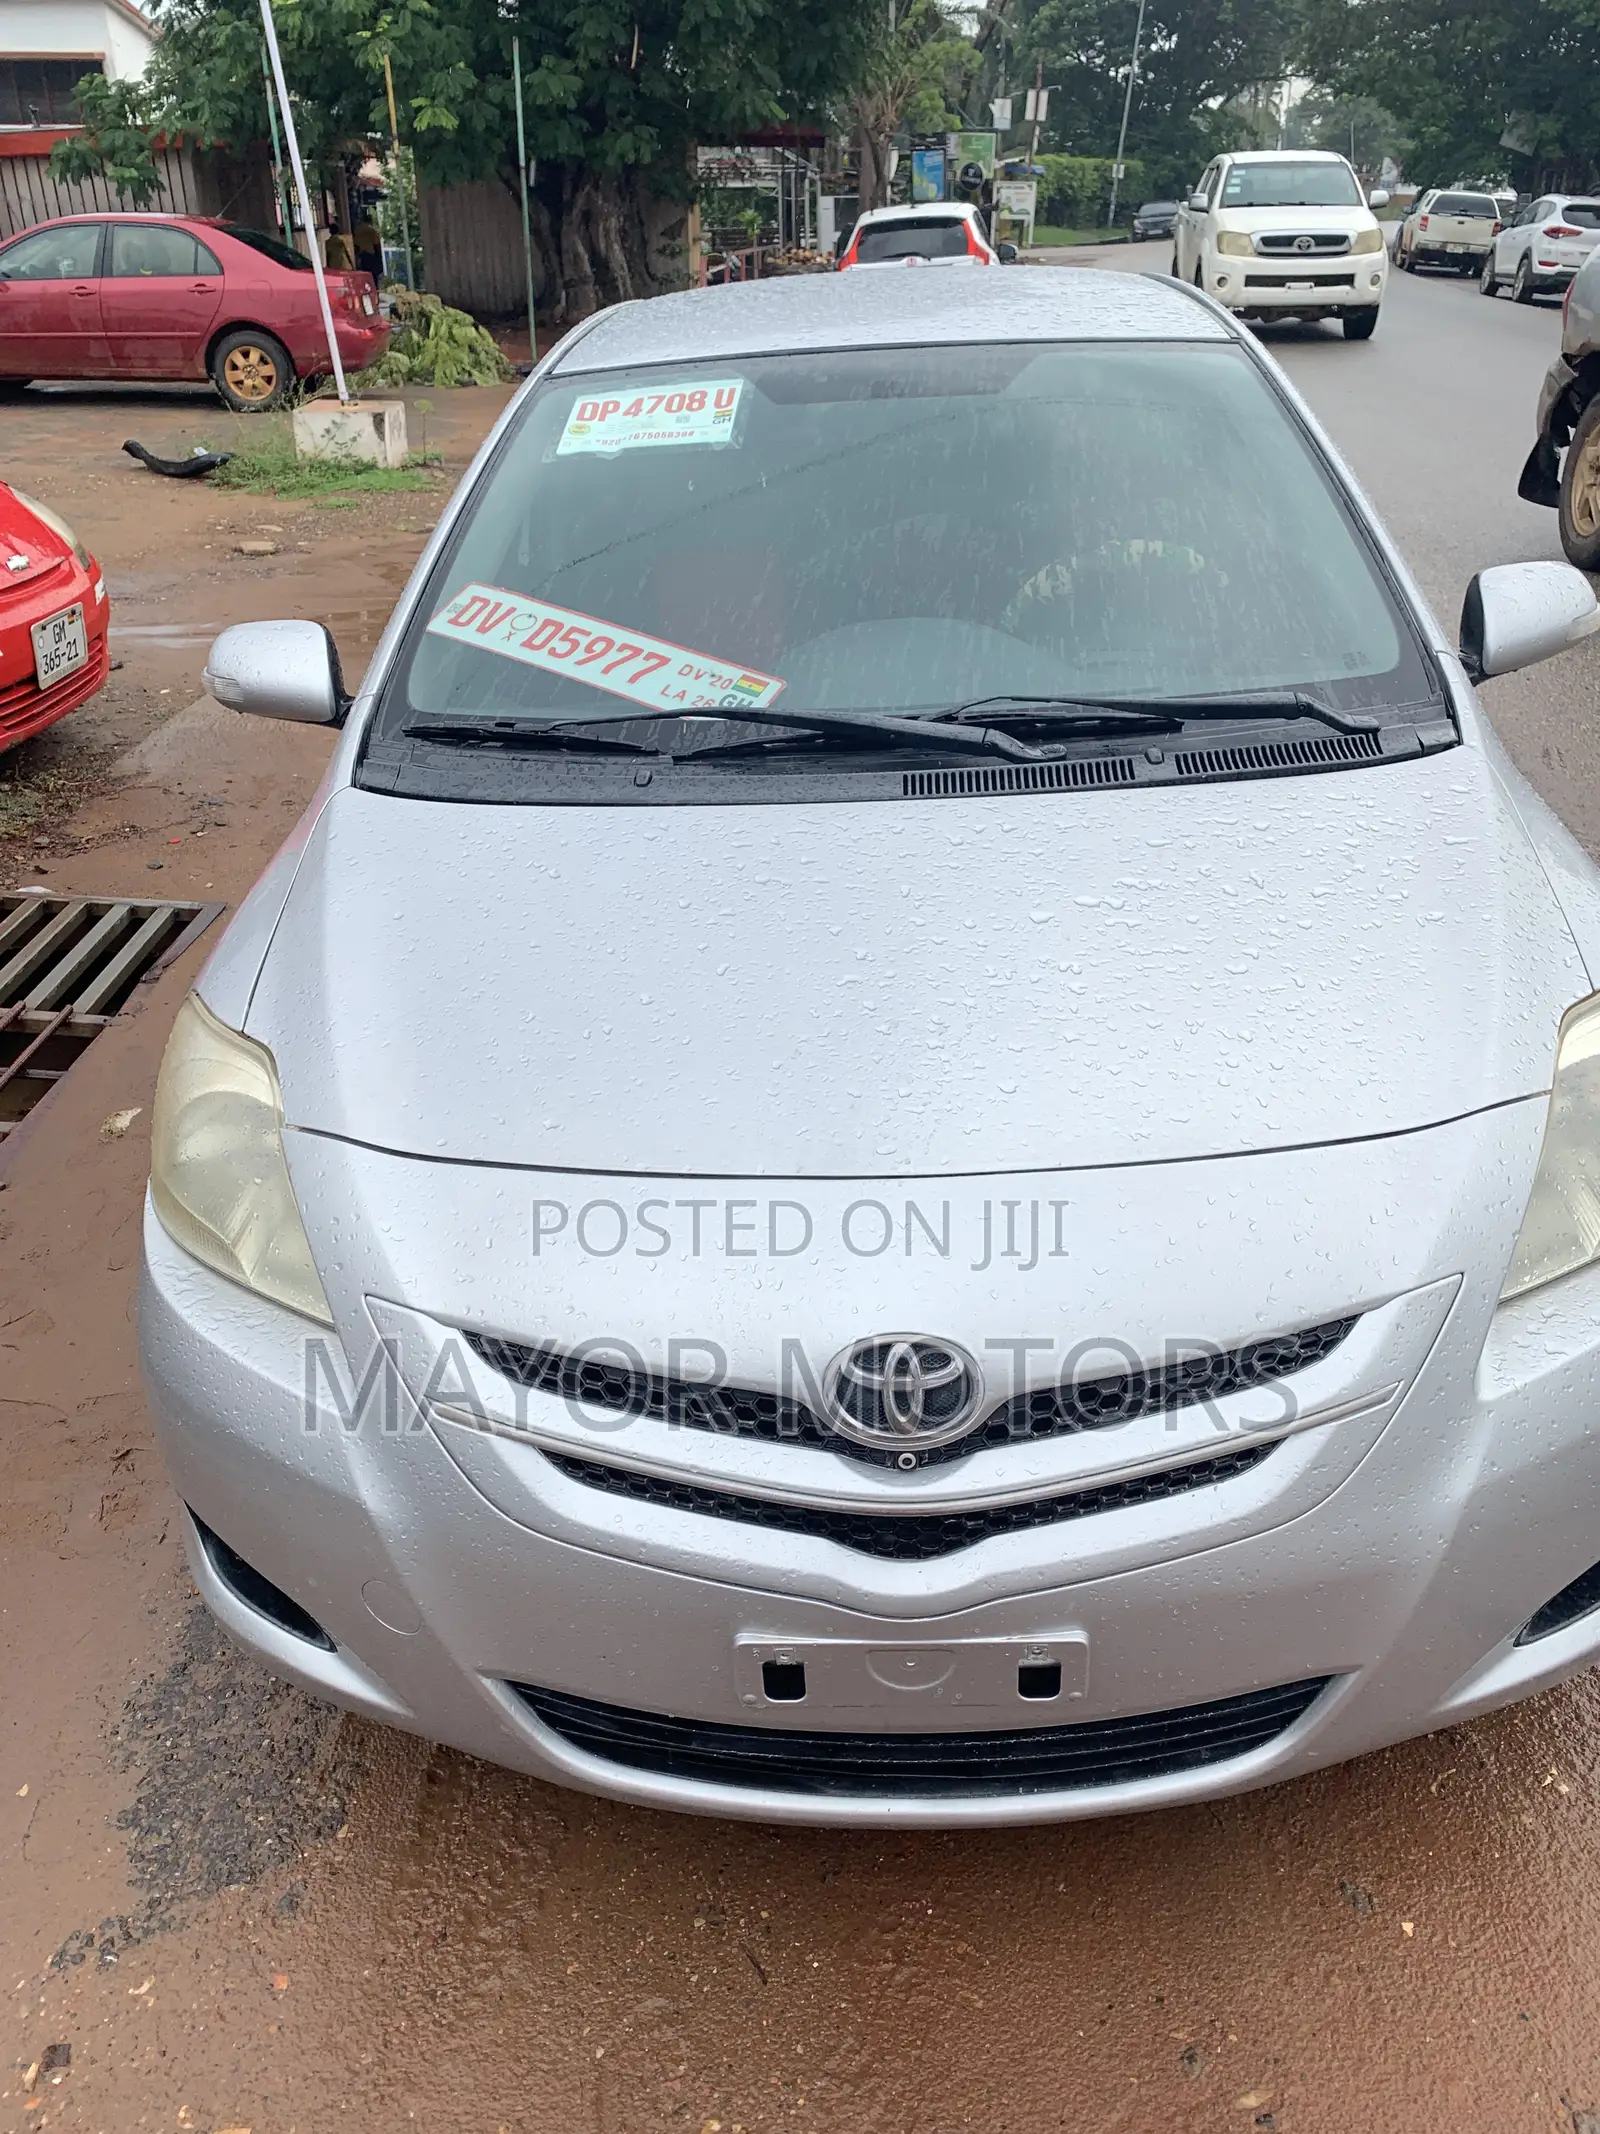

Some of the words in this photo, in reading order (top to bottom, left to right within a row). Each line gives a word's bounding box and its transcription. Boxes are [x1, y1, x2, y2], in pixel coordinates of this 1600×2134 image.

[576, 400, 621, 422] DP
[622, 390, 709, 418] 4708
[713, 387, 737, 410] U
[712, 417, 733, 425] GH
[52, 619, 67, 645] GM
[447, 595, 518, 635] DV
[520, 618, 673, 685] D5977
[42, 637, 80, 675] 365-21
[678, 664, 709, 681] DV
[660, 684, 687, 703] LA
